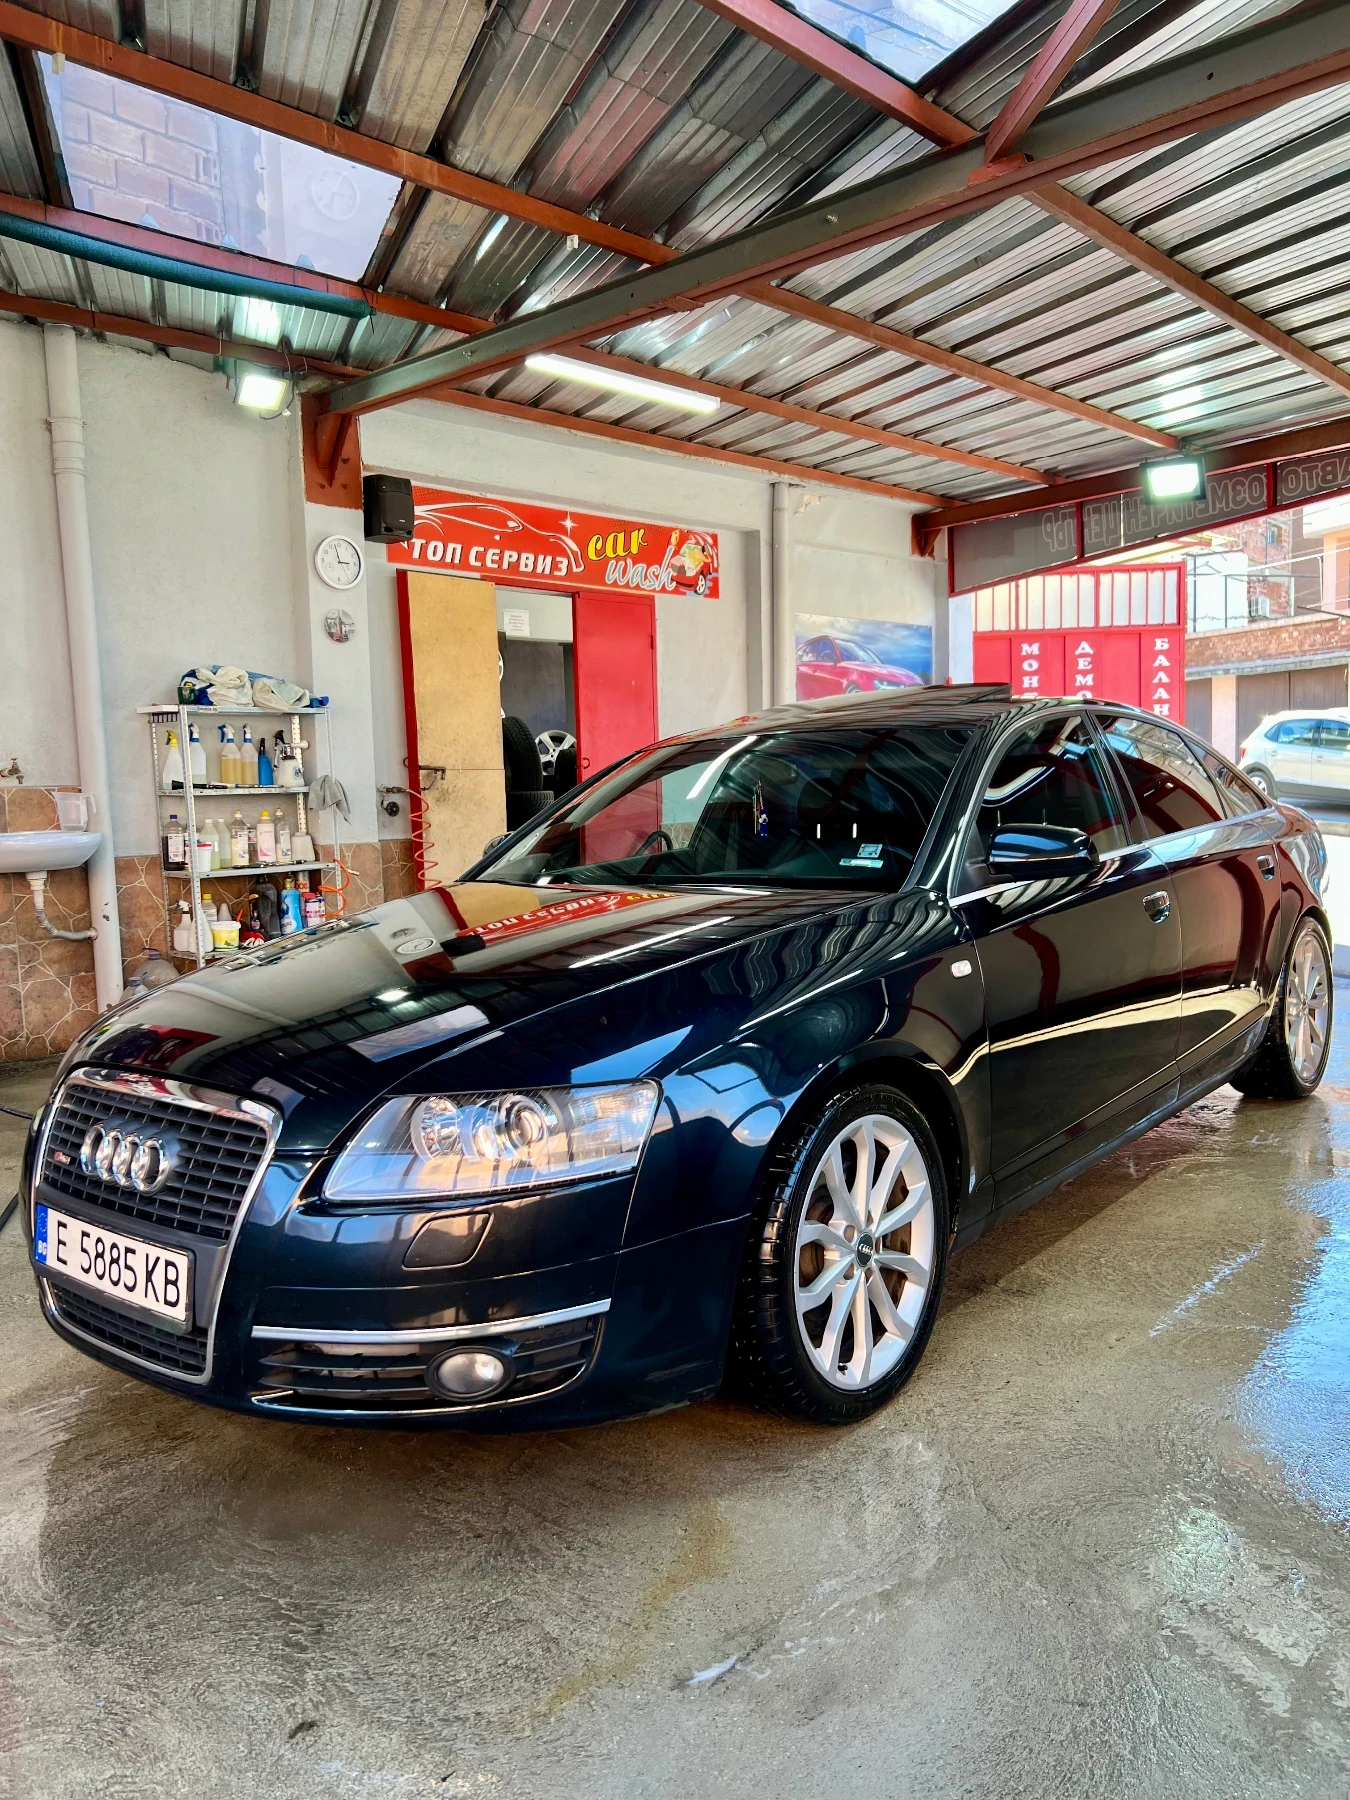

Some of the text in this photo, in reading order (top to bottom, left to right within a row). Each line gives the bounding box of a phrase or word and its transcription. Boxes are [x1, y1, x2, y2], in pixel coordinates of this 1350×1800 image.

[411, 538, 570, 578] ТОП СЕРВИЗ
[587, 527, 648, 561] car
[1152, 637, 1171, 716] БАЛАН
[80, 1229, 137, 1293] 5885
